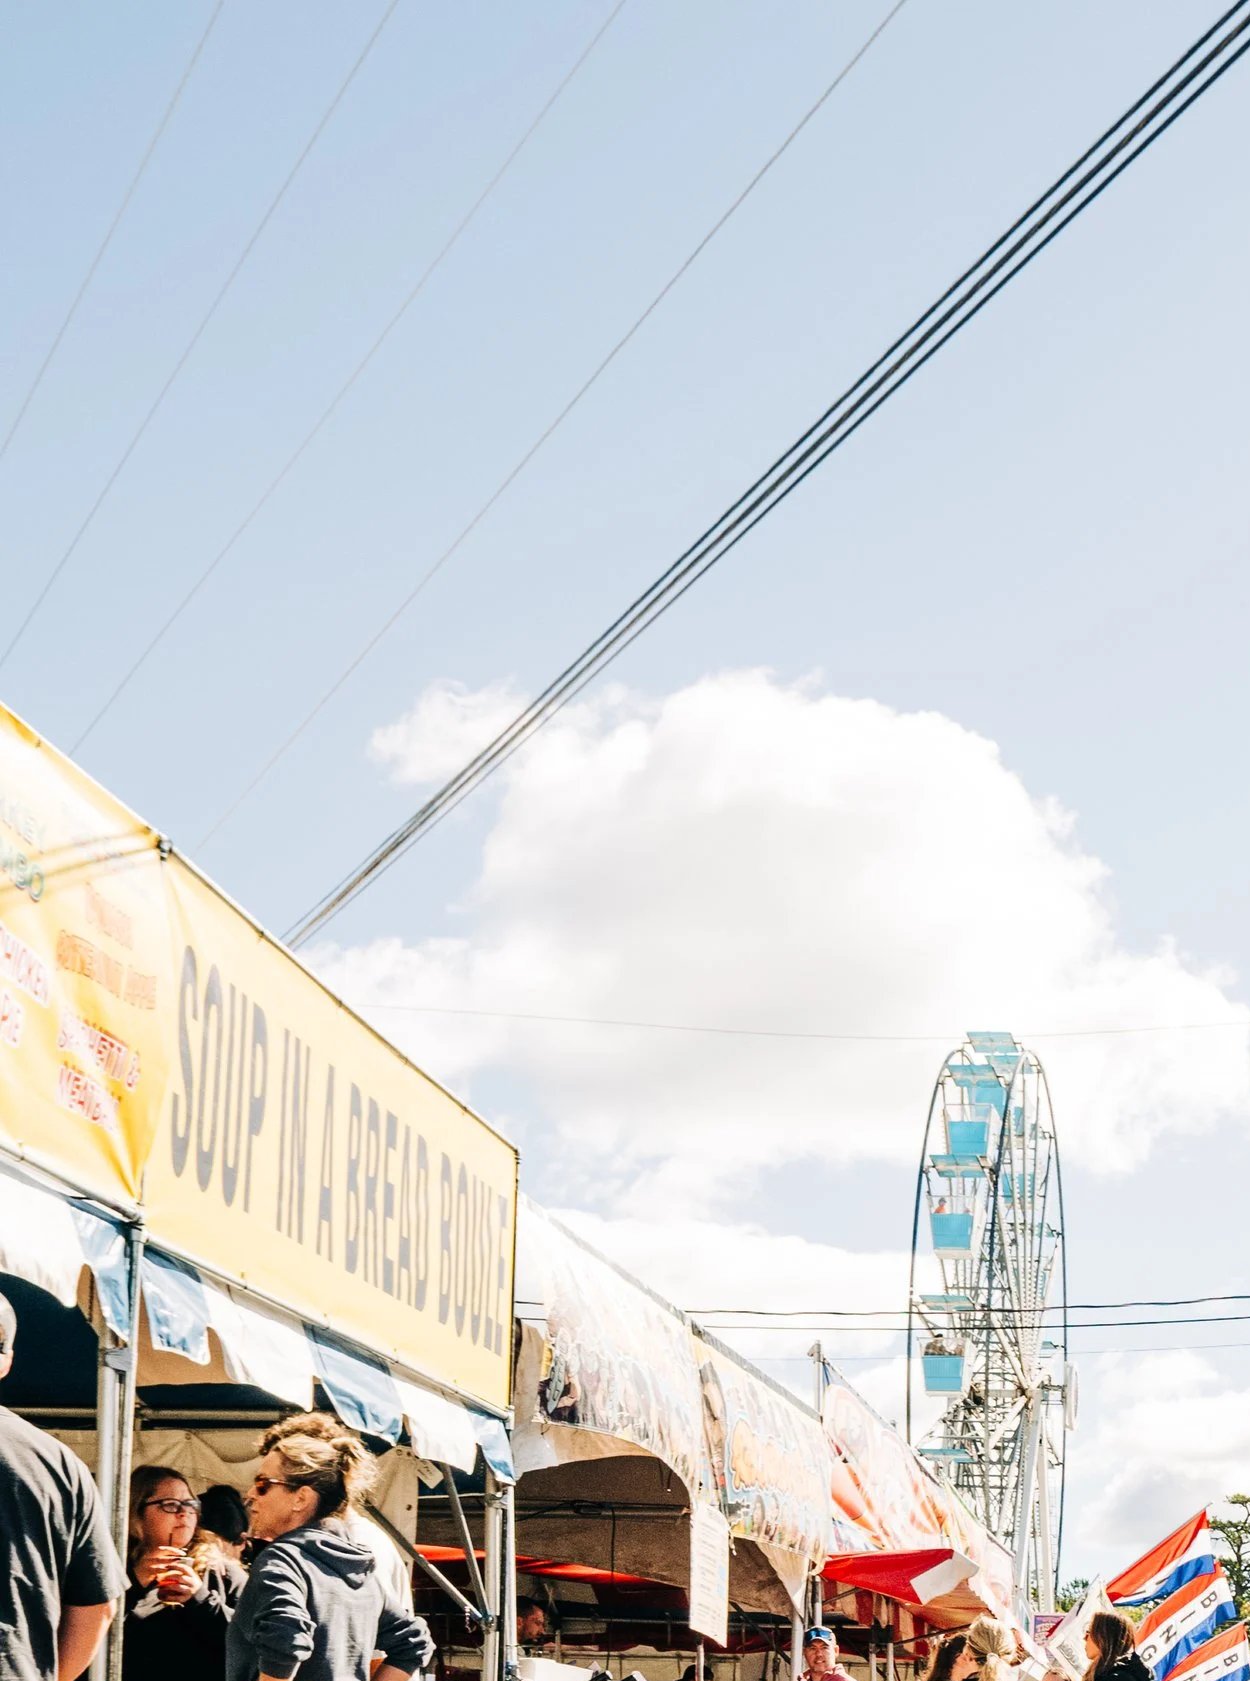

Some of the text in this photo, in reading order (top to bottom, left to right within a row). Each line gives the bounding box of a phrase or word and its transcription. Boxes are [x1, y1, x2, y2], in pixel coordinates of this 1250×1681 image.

[0, 923, 49, 1007] HICKEN
[170, 944, 508, 1358] SOUP IN A BREAD BOULE
[1140, 1590, 1219, 1664] BING
